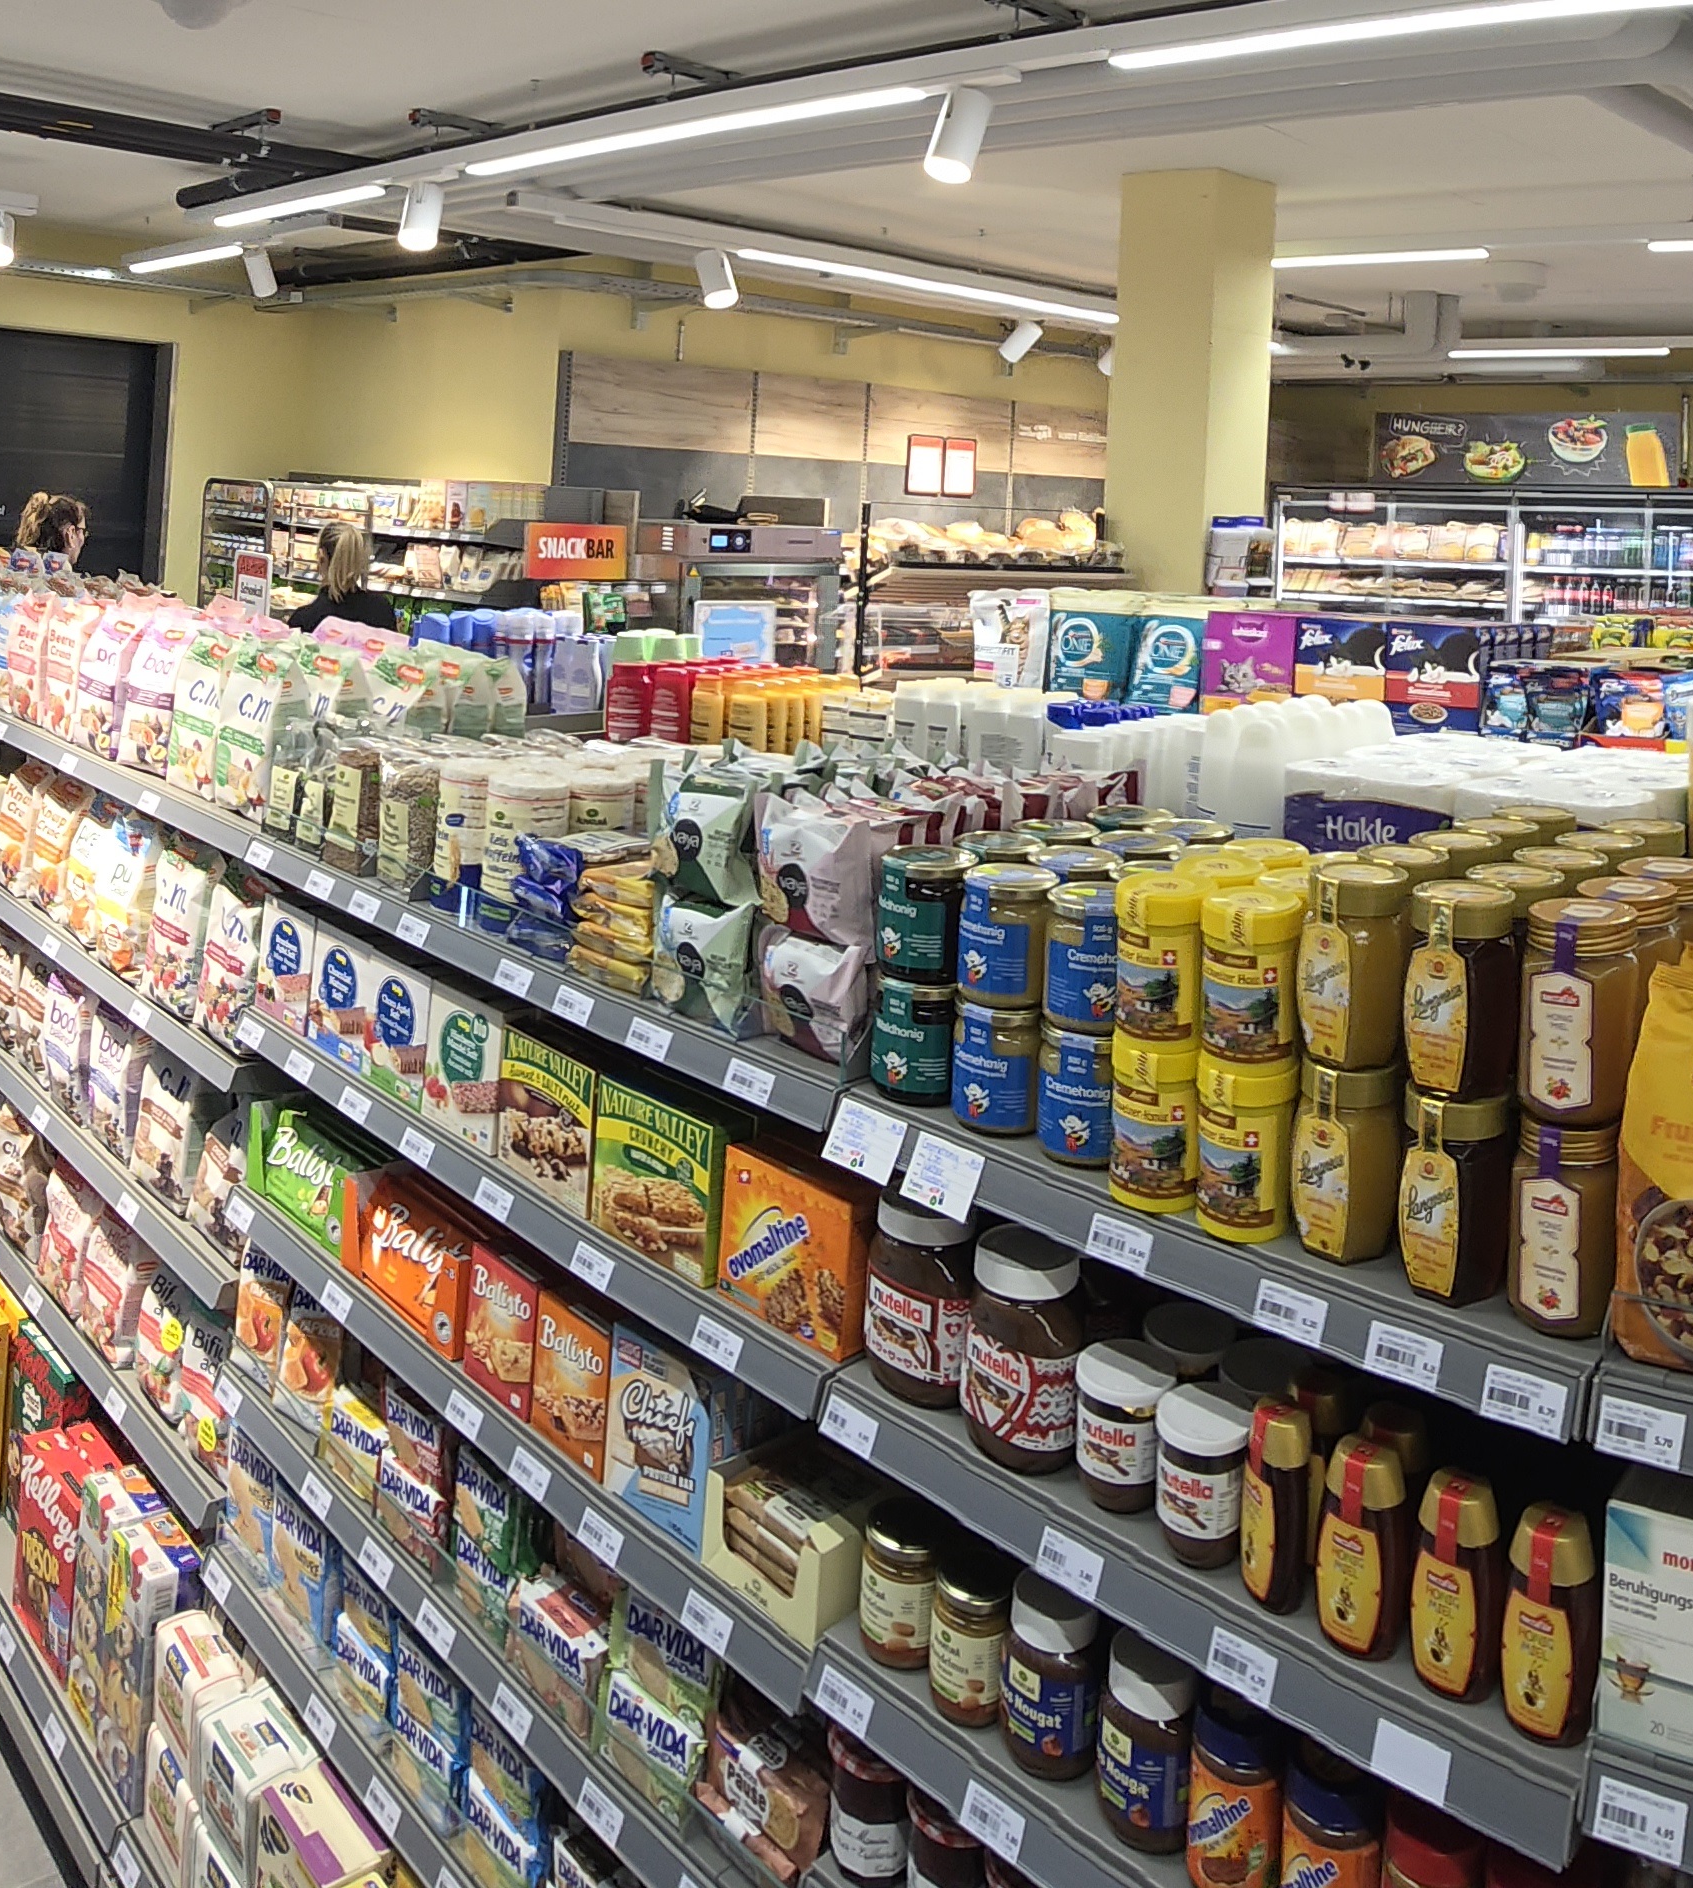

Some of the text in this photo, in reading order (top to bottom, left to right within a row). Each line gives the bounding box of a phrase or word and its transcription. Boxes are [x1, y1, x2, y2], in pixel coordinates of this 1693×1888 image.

[1325, 814, 1398, 845] Hakle
[506, 1031, 549, 1069] NATURE
[545, 1051, 590, 1099] VALLEY
[1045, 1076, 1111, 1101] Cremehonig
[599, 1078, 708, 1162] NATURE VALLEY
[473, 1264, 532, 1321] Balisto
[872, 1285, 924, 1325] nutella
[539, 1314, 604, 1375] Balisto
[970, 1338, 1022, 1387] nutella
[1081, 1418, 1136, 1449] nutella
[1160, 1465, 1214, 1501] nutella
[1013, 1694, 1063, 1730] Nougat
[1650, 1720, 1665, 1736] 20
